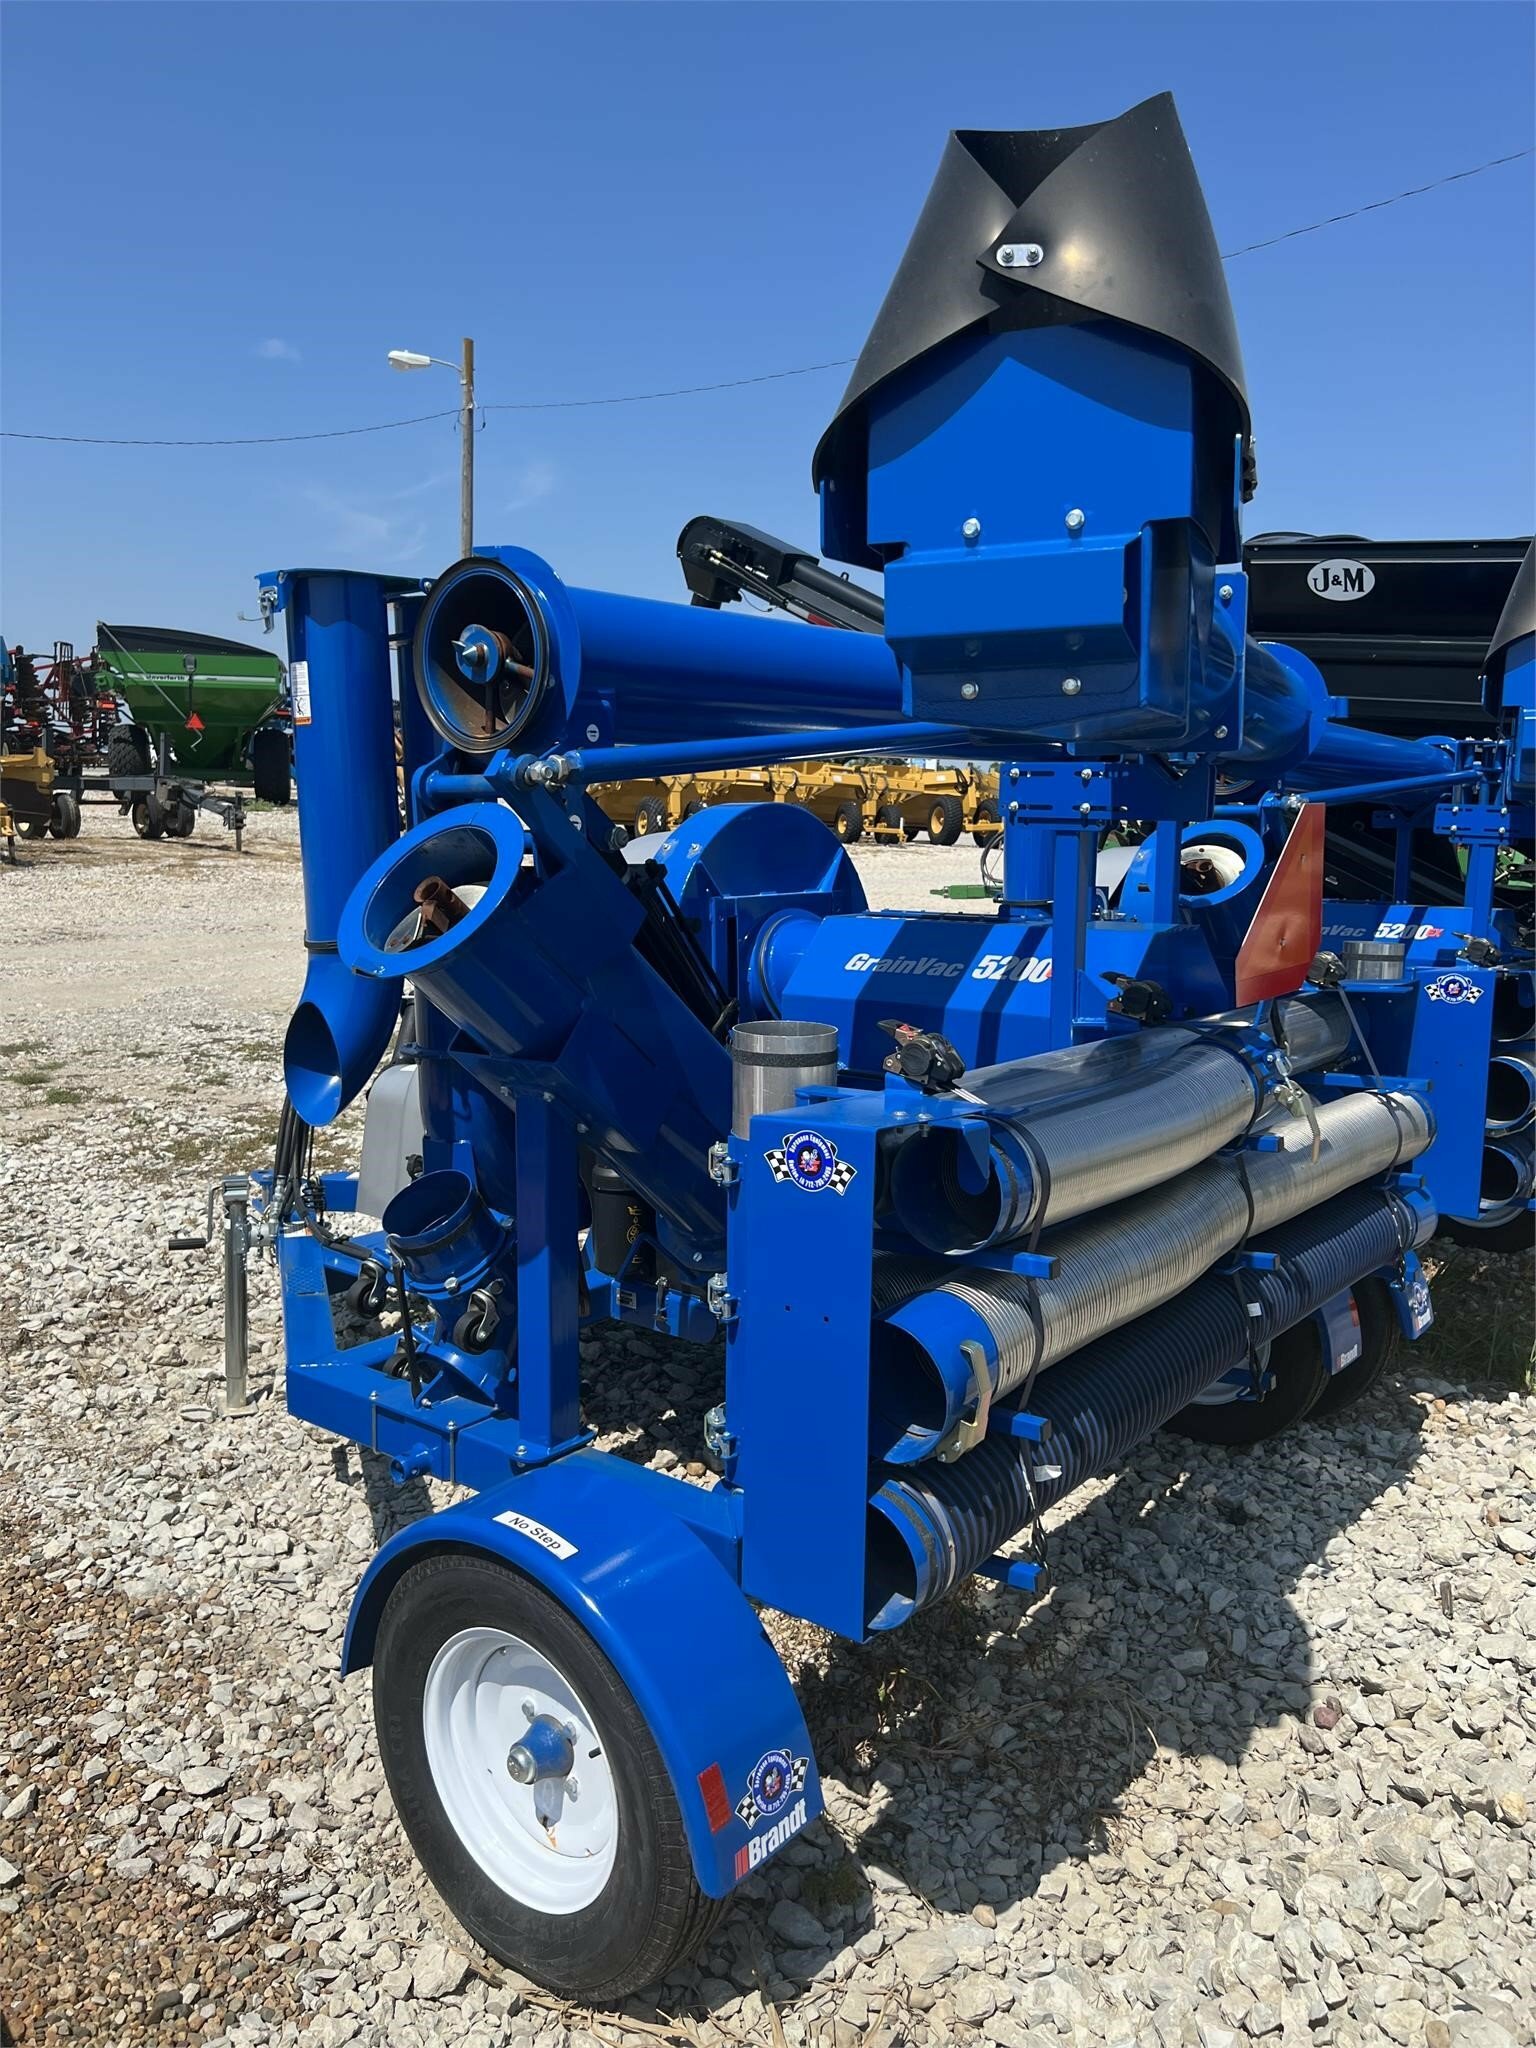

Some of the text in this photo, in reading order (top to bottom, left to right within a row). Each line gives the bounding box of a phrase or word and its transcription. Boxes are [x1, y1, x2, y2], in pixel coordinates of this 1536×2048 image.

[1312, 567, 1366, 593] J&M
[844, 952, 1053, 984] GrainVac 5200
[508, 1517, 562, 1550] No Step
[748, 1797, 808, 1870] Brandt
